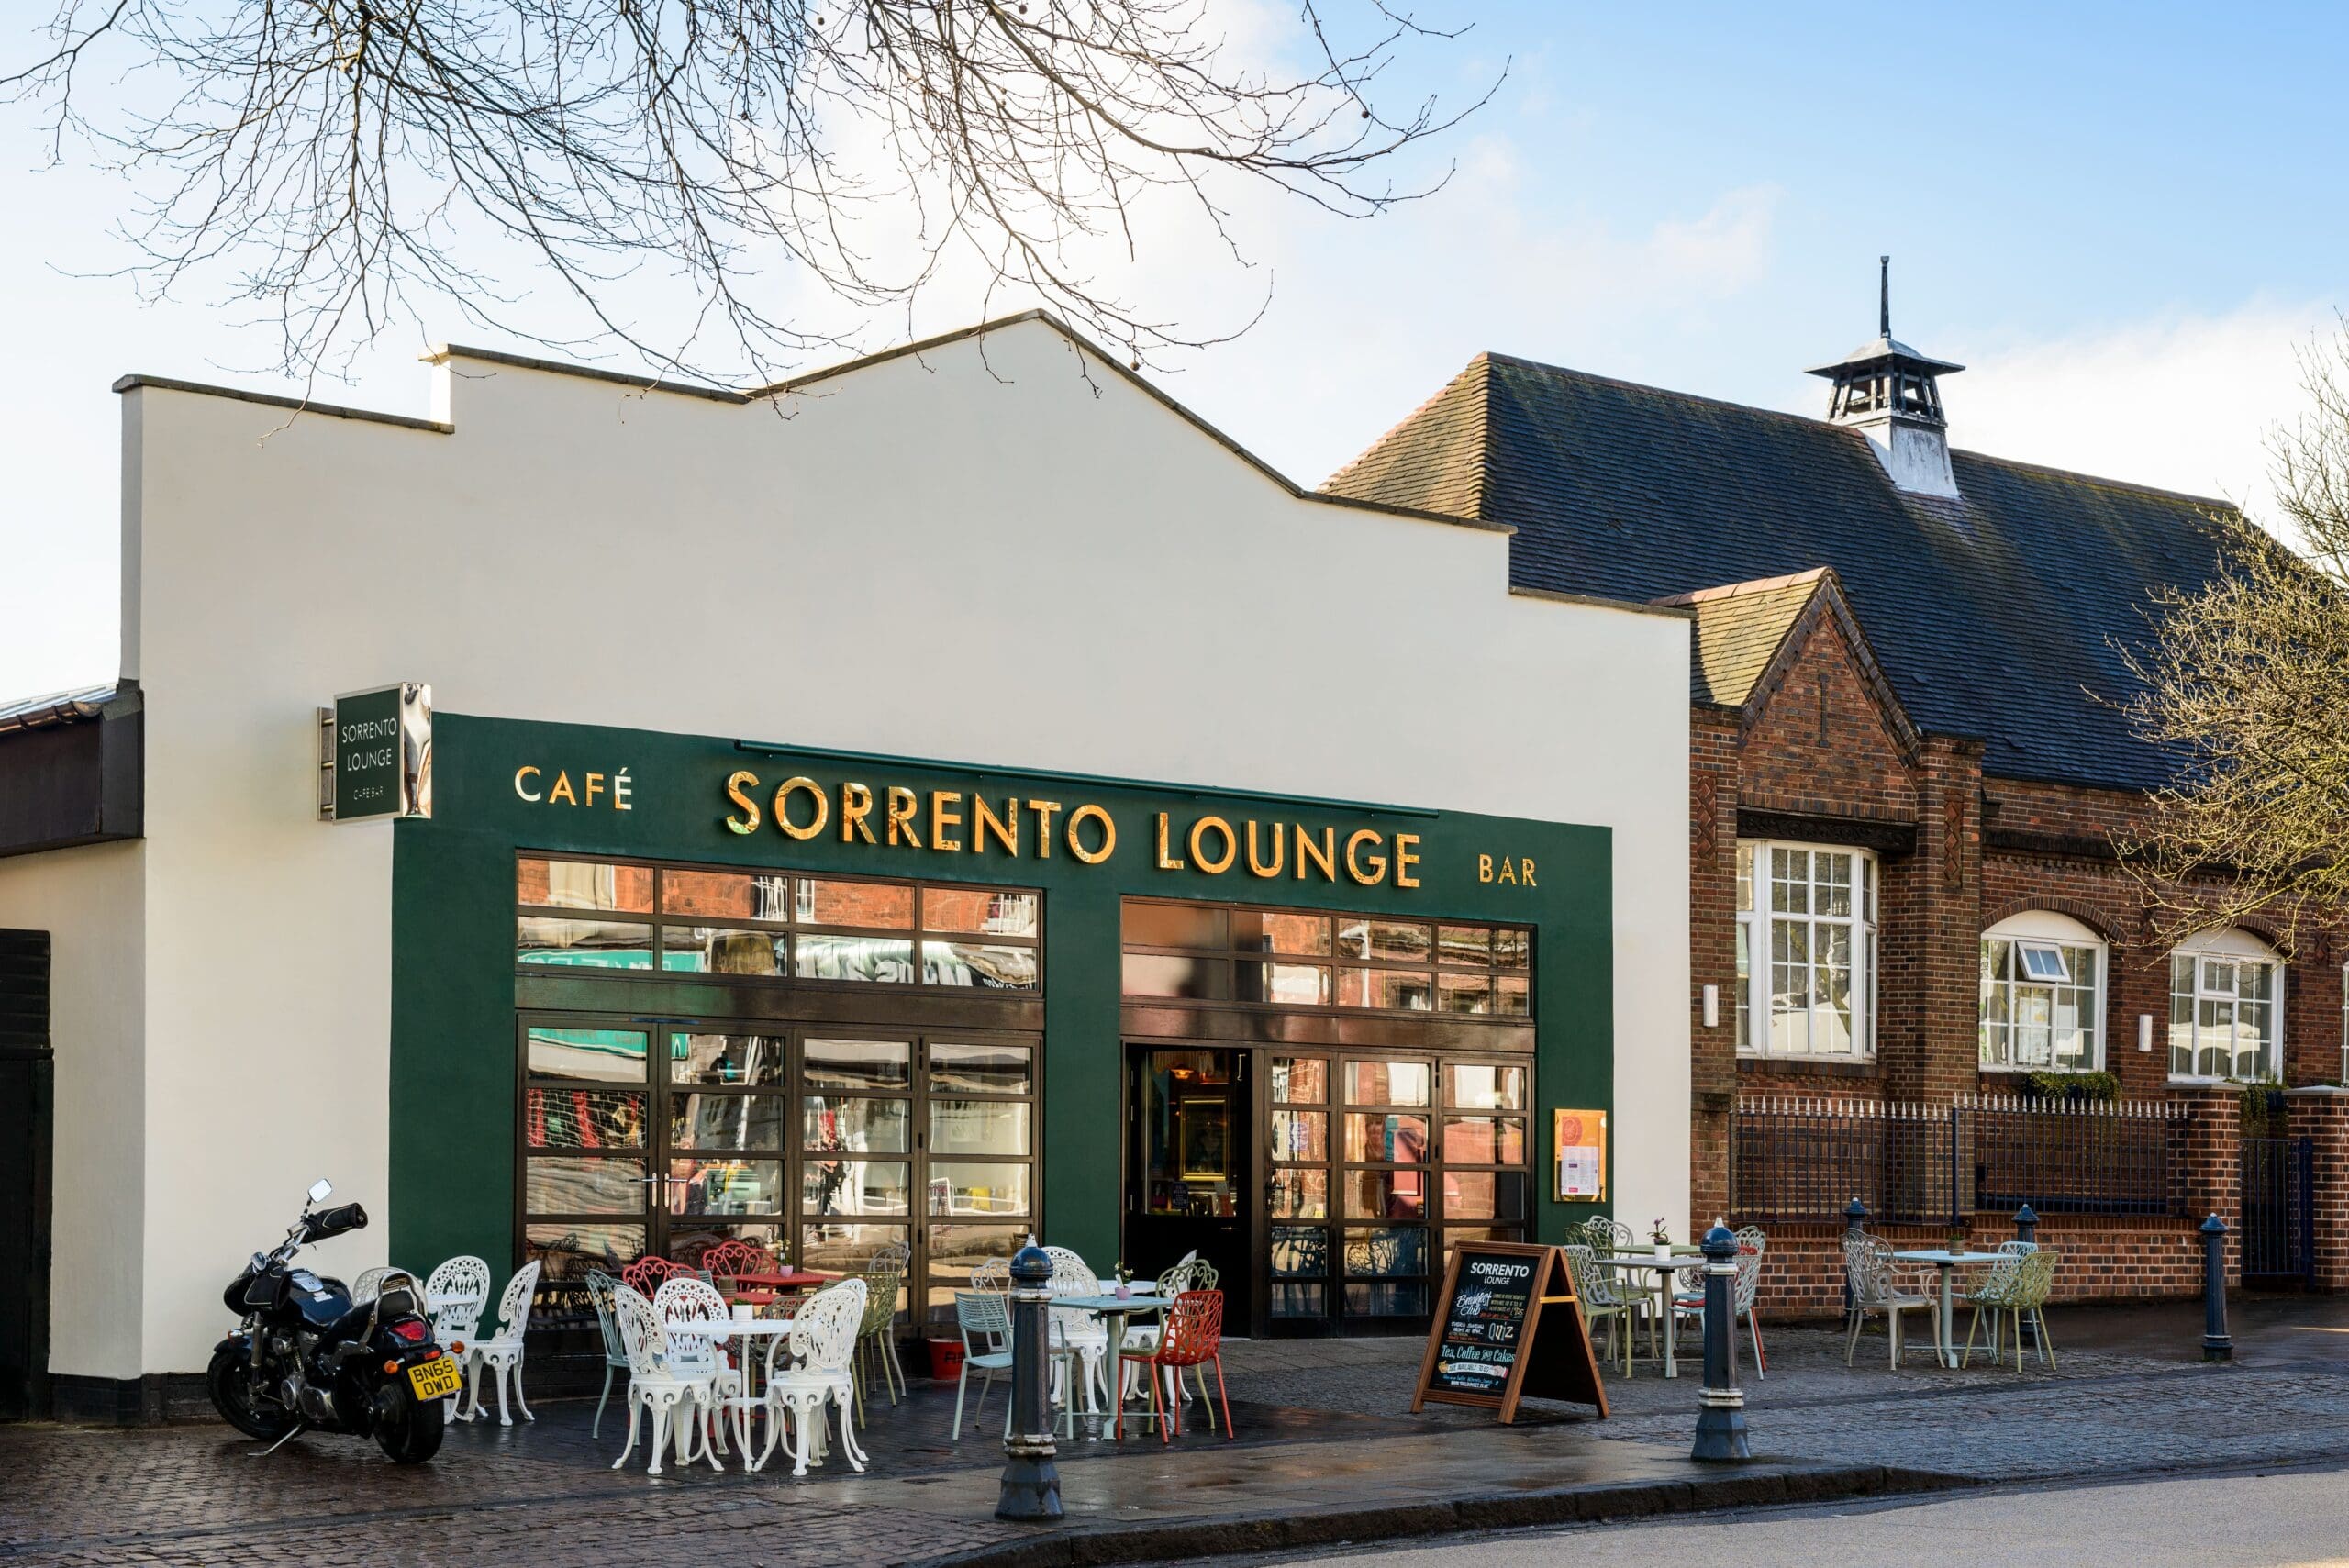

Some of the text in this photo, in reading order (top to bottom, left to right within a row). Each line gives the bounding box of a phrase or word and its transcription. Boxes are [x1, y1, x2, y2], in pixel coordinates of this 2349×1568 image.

[342, 717, 397, 744] SORRENTO
[347, 748, 392, 772] LOUNGE
[514, 765, 1538, 889] CAFÉ SORRENTO LOUNGE BAR
[1470, 1262, 1530, 1278] SORRENTO
[1484, 1276, 1510, 1285] LOUNGE
[1456, 1290, 1492, 1307] Breakfast
[1460, 1303, 1481, 1316] Club
[1441, 1344, 1456, 1360] Tea,
[1456, 1345, 1481, 1361] Coffee
[1493, 1348, 1516, 1363] Cakes
[412, 1359, 454, 1384] BN65
[422, 1375, 454, 1396] OWD
